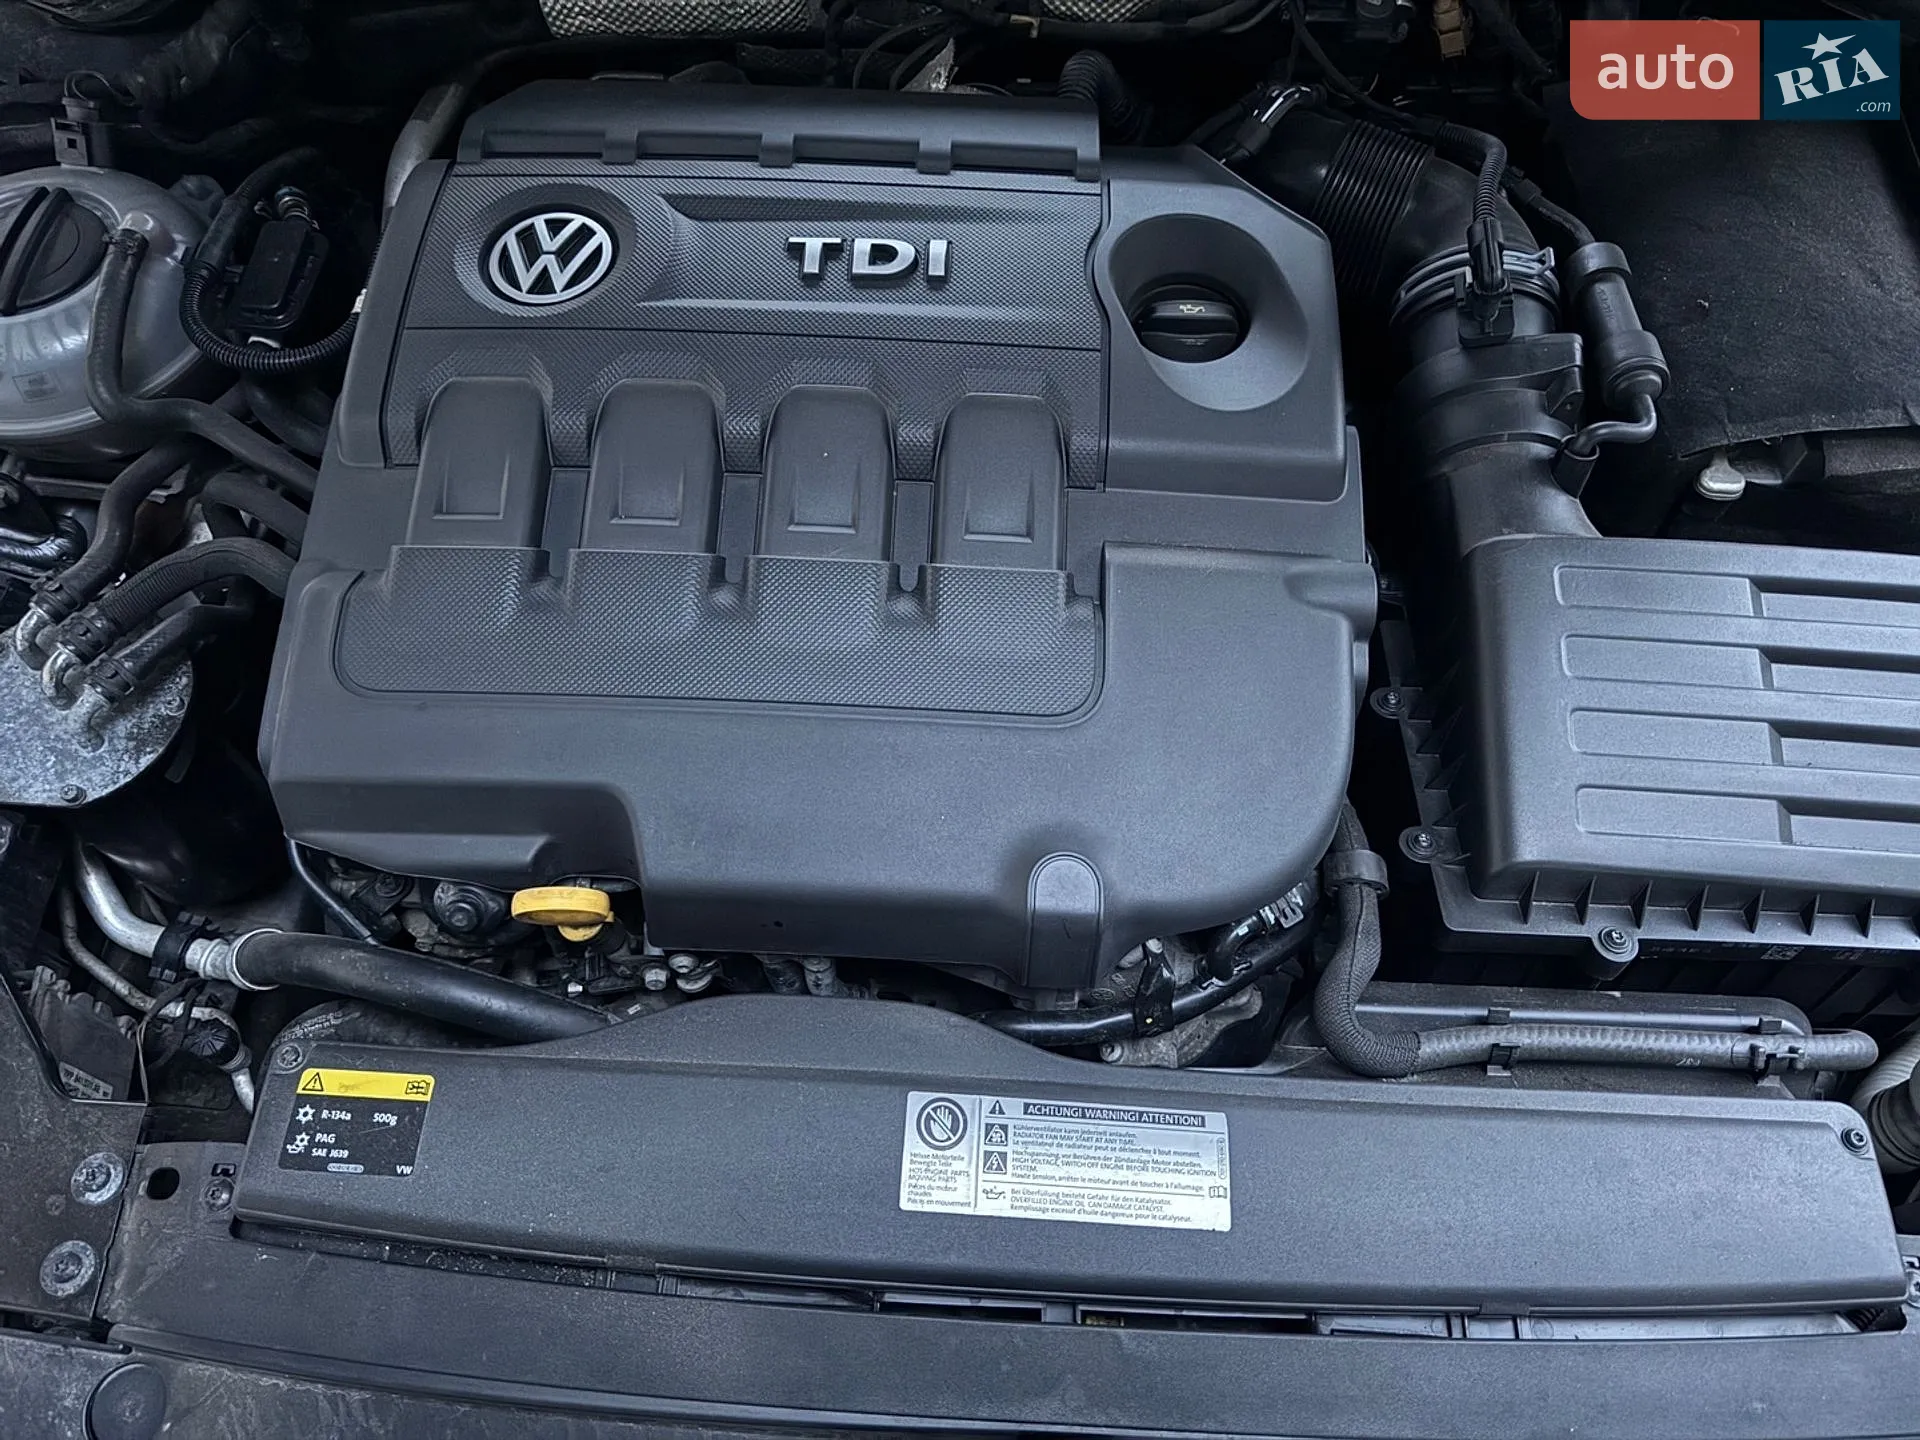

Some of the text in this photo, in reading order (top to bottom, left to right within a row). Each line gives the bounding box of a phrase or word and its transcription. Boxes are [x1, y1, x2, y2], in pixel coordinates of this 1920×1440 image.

[787, 236, 948, 278] TDI
[321, 1109, 398, 1126] R-134a 500g
[1027, 1104, 1202, 1126] ACHTUNG! WARNING! ATTENTION!
[314, 1133, 336, 1144] PAG
[312, 1148, 349, 1158] SAE J639
[396, 1164, 413, 1175] VW
